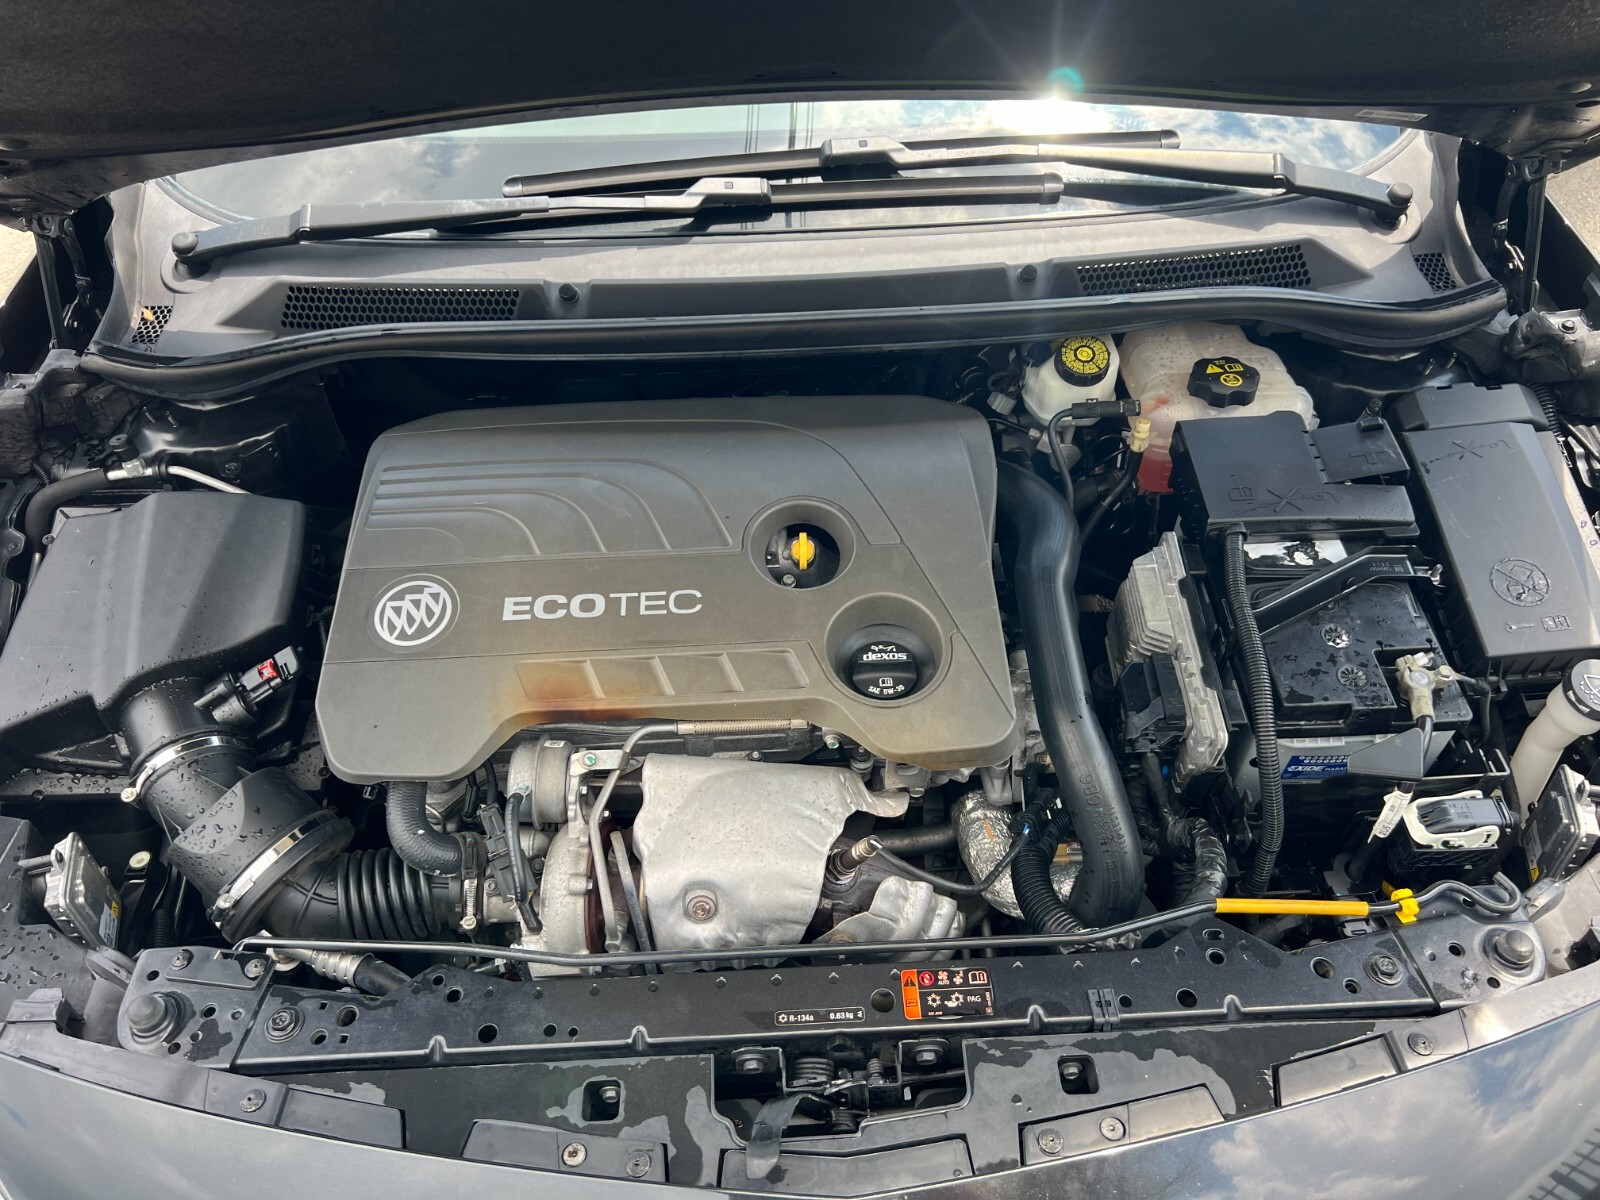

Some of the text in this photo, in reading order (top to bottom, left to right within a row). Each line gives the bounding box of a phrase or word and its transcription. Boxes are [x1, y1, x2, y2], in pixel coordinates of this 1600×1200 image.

[502, 589, 703, 621] ECOTEC
[863, 652, 908, 661] dexos
[868, 685, 905, 695] SAE 5W-30
[789, 1013, 814, 1022] R-134a
